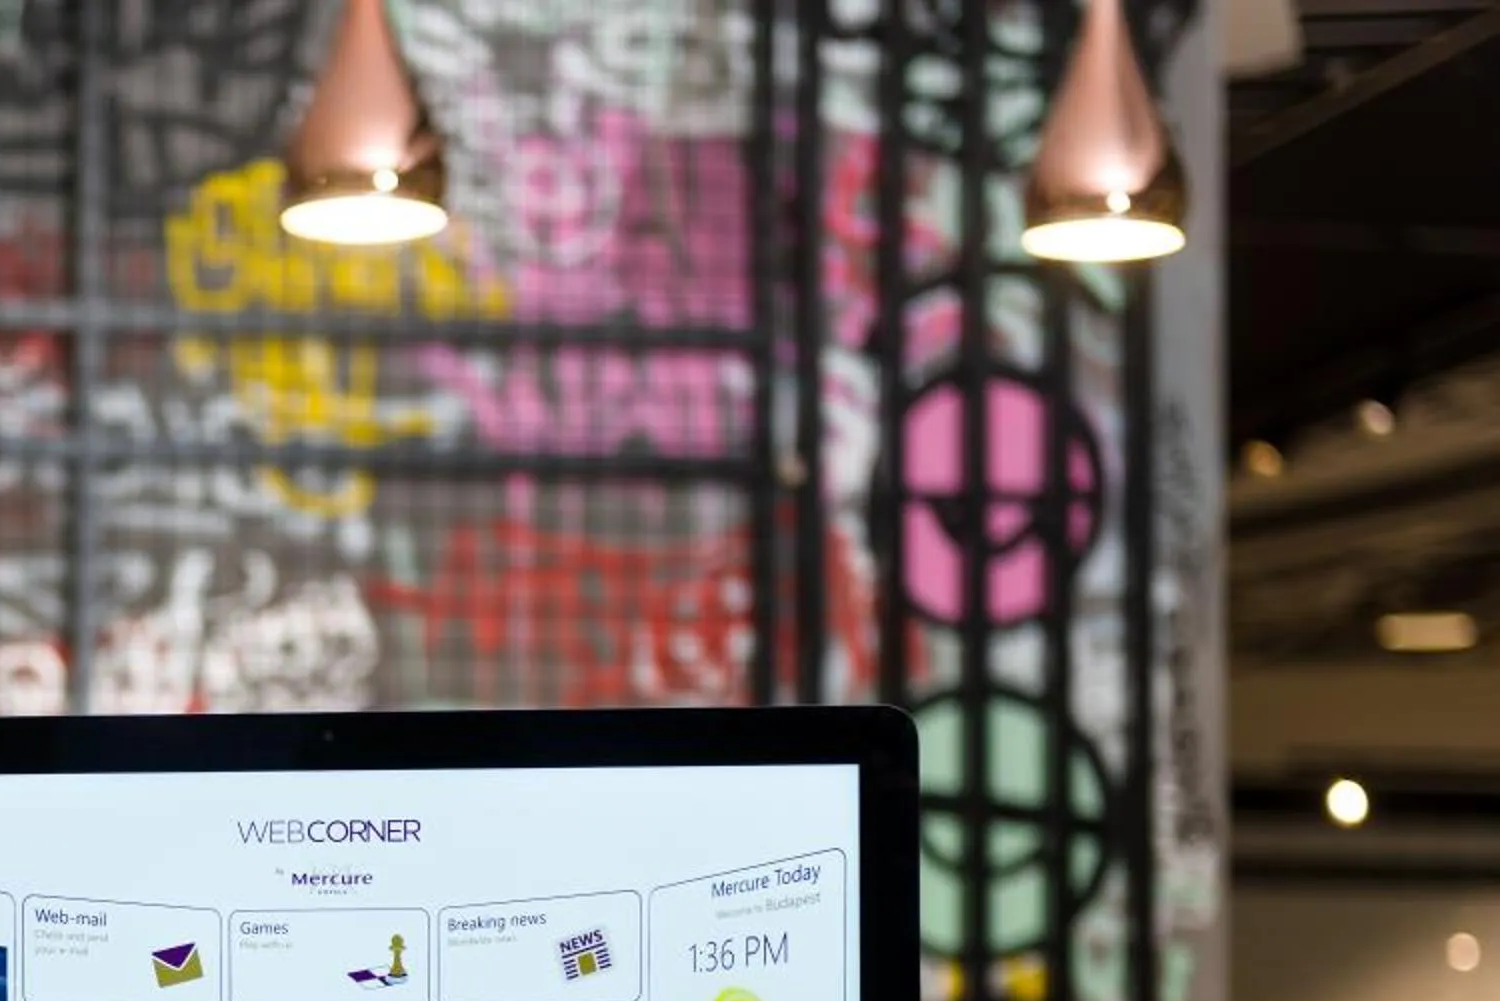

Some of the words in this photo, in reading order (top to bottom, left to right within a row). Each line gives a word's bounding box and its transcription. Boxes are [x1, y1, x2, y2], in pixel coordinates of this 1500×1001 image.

[236, 818, 422, 844] WEBCORNER
[291, 872, 373, 886] Mercure
[711, 873, 771, 898] Mercure
[774, 863, 821, 886] Today
[35, 908, 108, 927] Web-mail
[239, 921, 290, 936] Games
[447, 916, 506, 934] Breaking
[510, 913, 548, 927] news
[559, 929, 604, 953] NEWS
[688, 938, 736, 974] 1:36
[744, 931, 790, 968] PM
